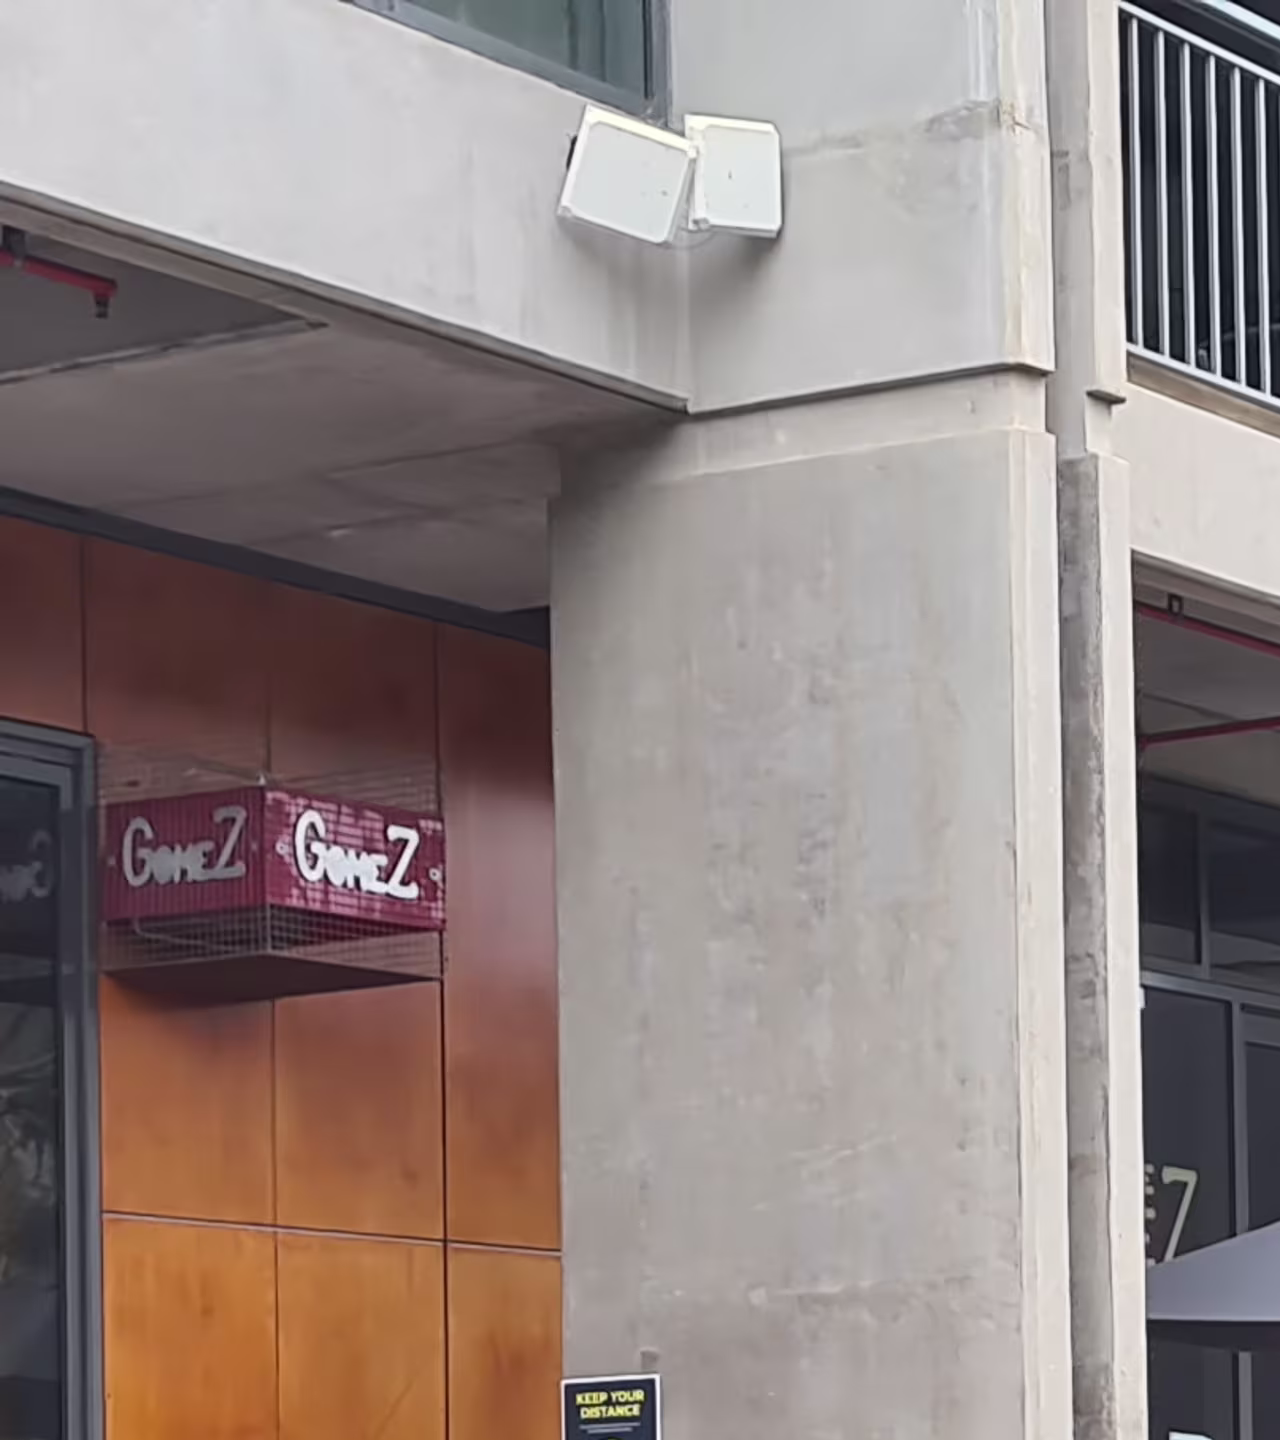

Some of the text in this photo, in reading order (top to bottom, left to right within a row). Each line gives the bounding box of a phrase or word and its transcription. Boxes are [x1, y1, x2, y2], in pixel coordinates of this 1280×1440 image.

[575, 1389, 645, 1405] KEEP YOUR
[580, 1404, 641, 1420] DISTANCE
